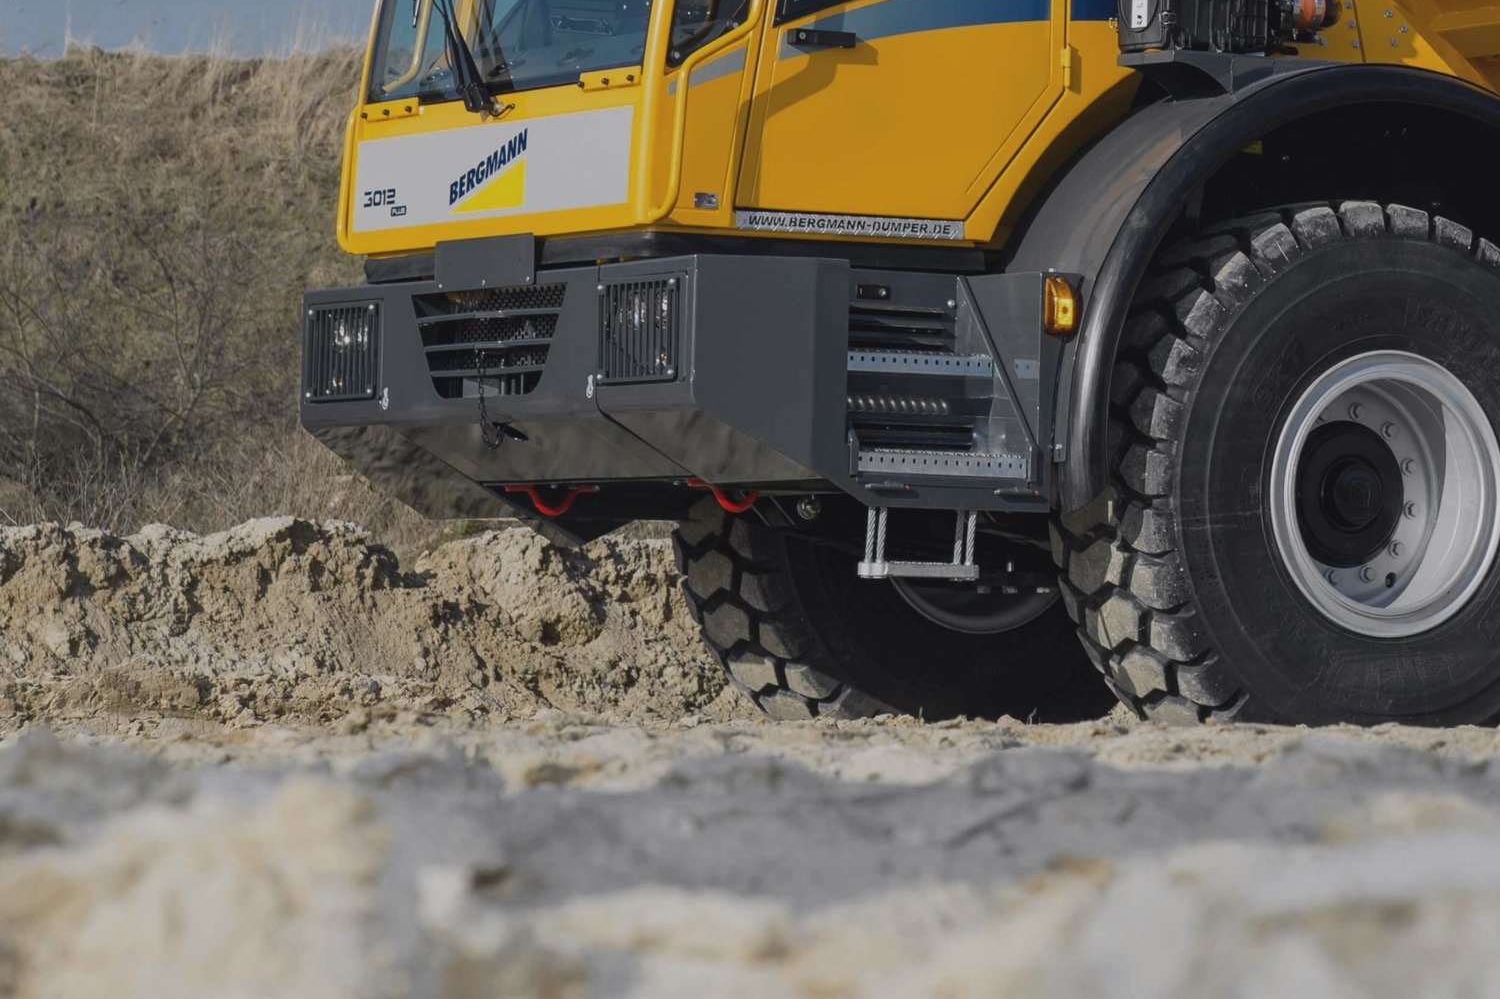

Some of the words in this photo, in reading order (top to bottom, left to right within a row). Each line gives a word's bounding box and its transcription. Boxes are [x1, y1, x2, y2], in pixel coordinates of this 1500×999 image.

[449, 128, 527, 206] BERGMANN
[363, 188, 396, 208] 3012
[391, 206, 406, 216] PLUS
[748, 214, 952, 235] WWW.BERGMANN-DUMPER.DE
